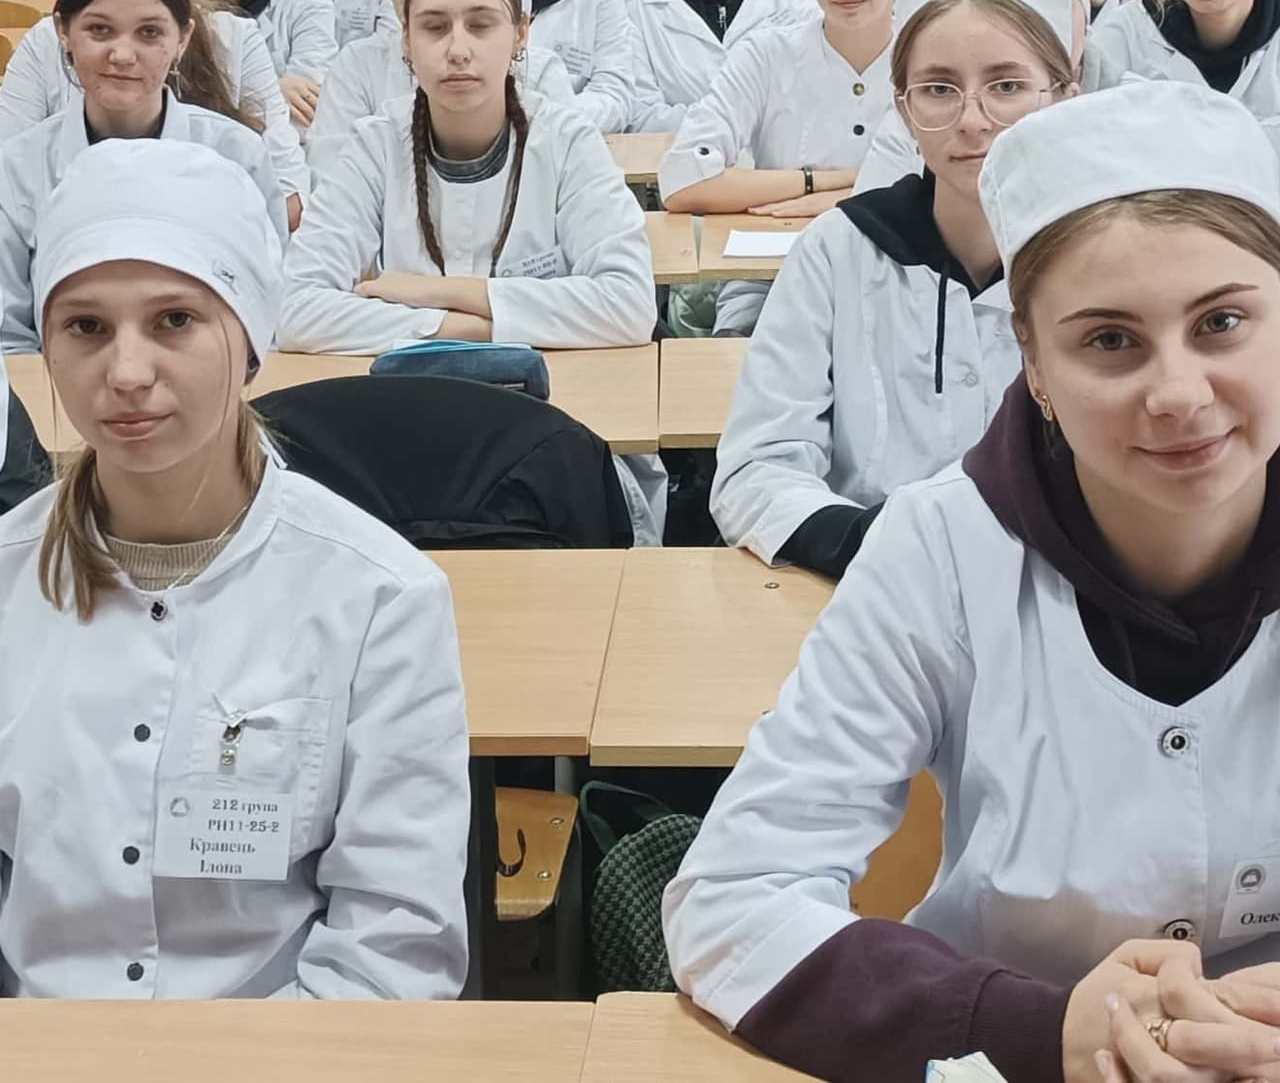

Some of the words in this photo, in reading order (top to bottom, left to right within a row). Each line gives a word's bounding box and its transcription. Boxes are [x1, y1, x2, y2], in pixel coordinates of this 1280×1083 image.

[212, 798, 239, 811] 212
[241, 802, 278, 815] група
[190, 837, 256, 855] Кравець
[200, 859, 242, 874] Ілона
